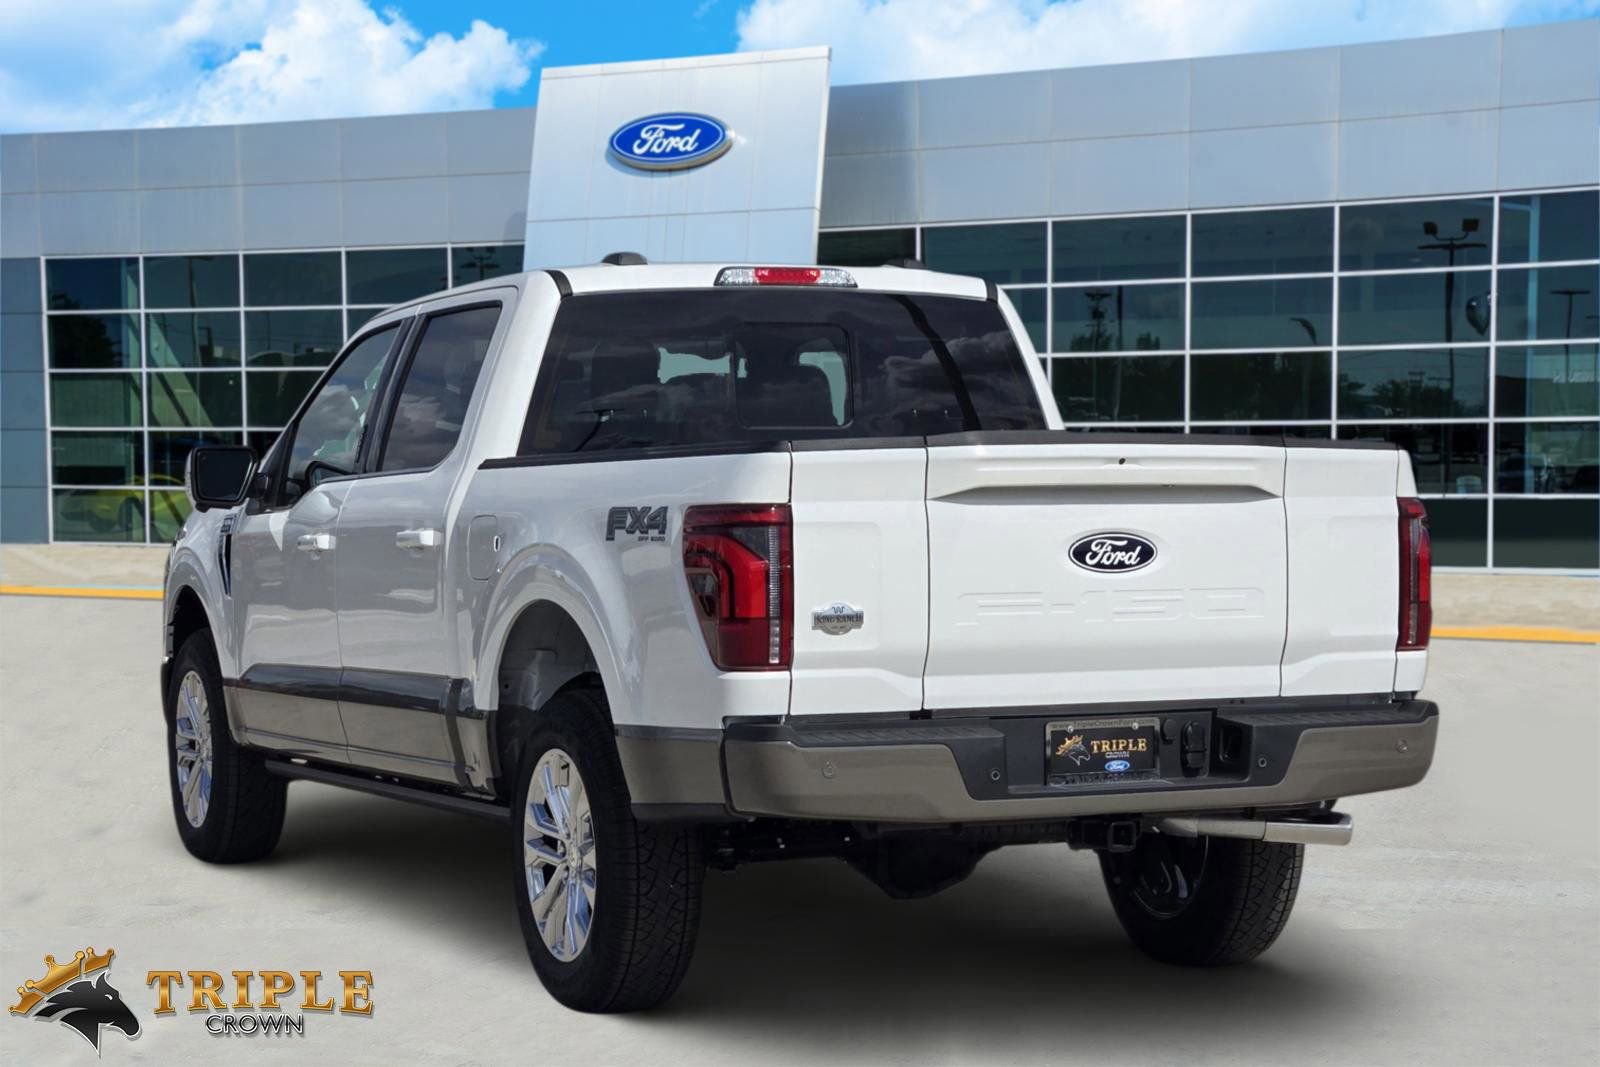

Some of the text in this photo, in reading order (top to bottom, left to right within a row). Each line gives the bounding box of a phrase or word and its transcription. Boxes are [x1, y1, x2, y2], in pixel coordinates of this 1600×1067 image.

[632, 123, 702, 155] Ford
[605, 505, 669, 542] FX4
[1084, 538, 1141, 566] Ford
[1090, 738, 1148, 754] TRIPLE
